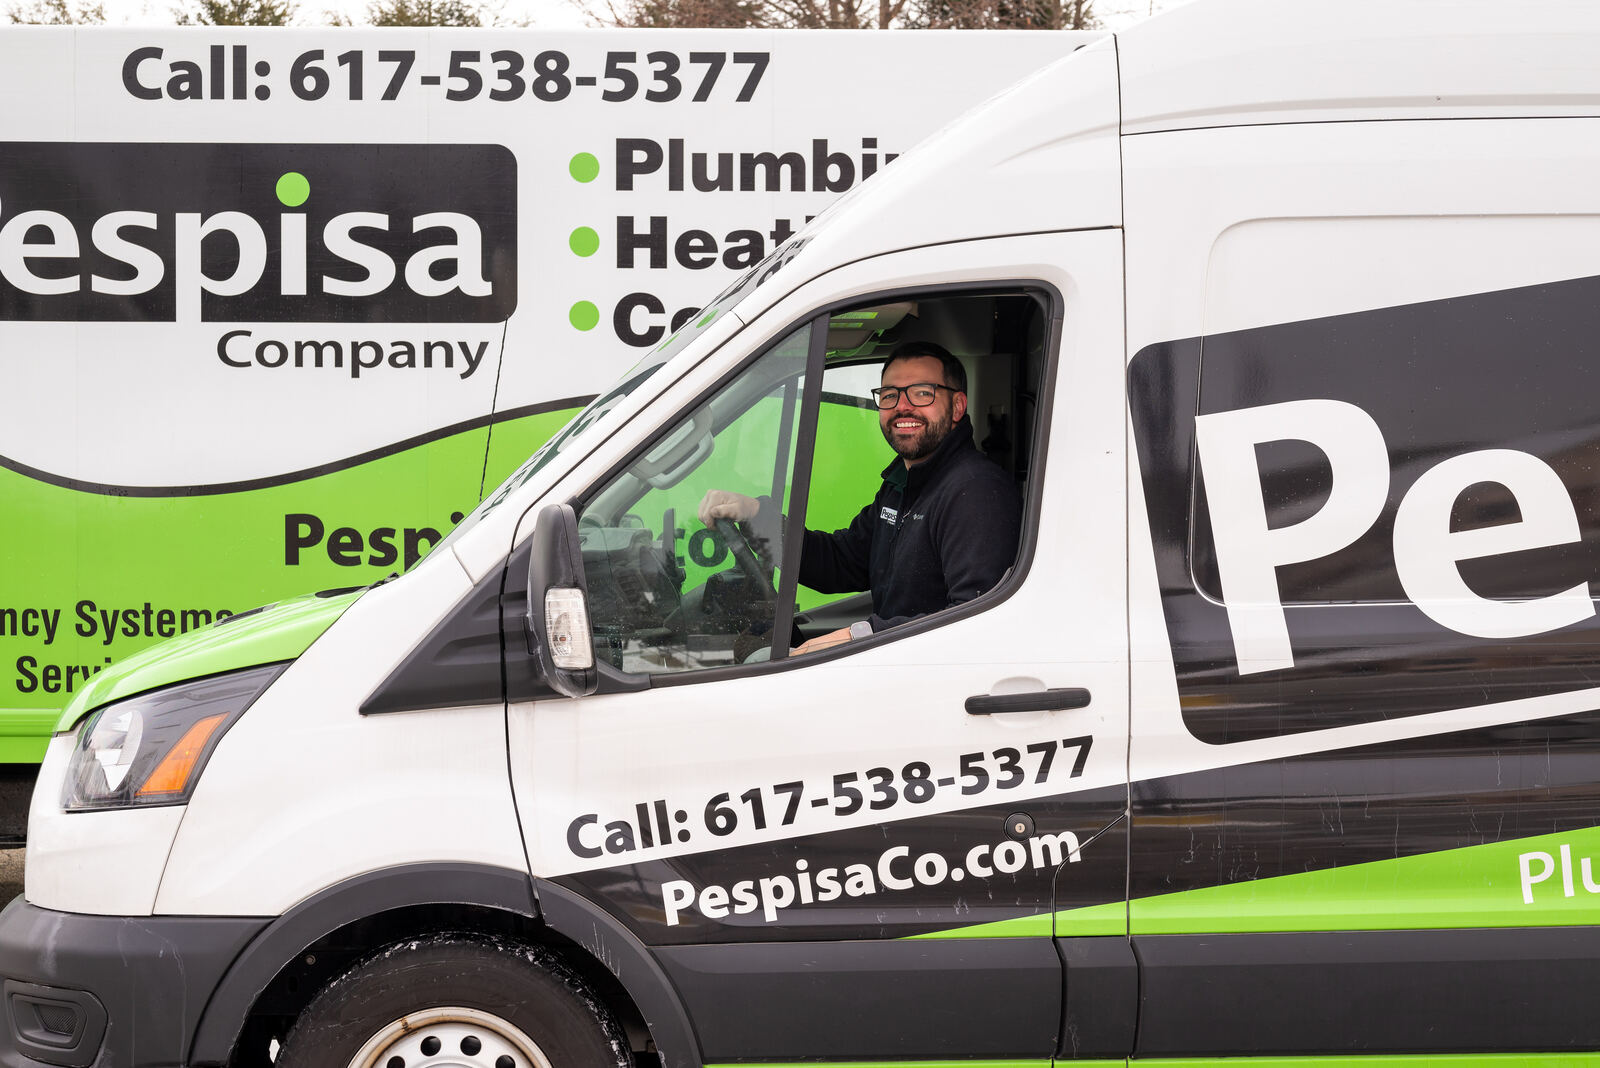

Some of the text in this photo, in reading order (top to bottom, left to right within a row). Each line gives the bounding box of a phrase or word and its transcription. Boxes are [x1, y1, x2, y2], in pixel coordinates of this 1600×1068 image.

[122, 45, 770, 102] Call: 617-538-5377
[616, 137, 900, 193] Plumbi
[0, 173, 493, 322] espisa
[617, 216, 816, 271] Heat
[217, 329, 489, 379] Company
[285, 511, 464, 573] Pesp
[1195, 399, 1597, 675] Pe
[0, 608, 61, 645] ncy
[16, 655, 112, 693] Serv
[566, 735, 1094, 859] Call: 617-538-5377
[661, 830, 1082, 926] PespisaCo.com
